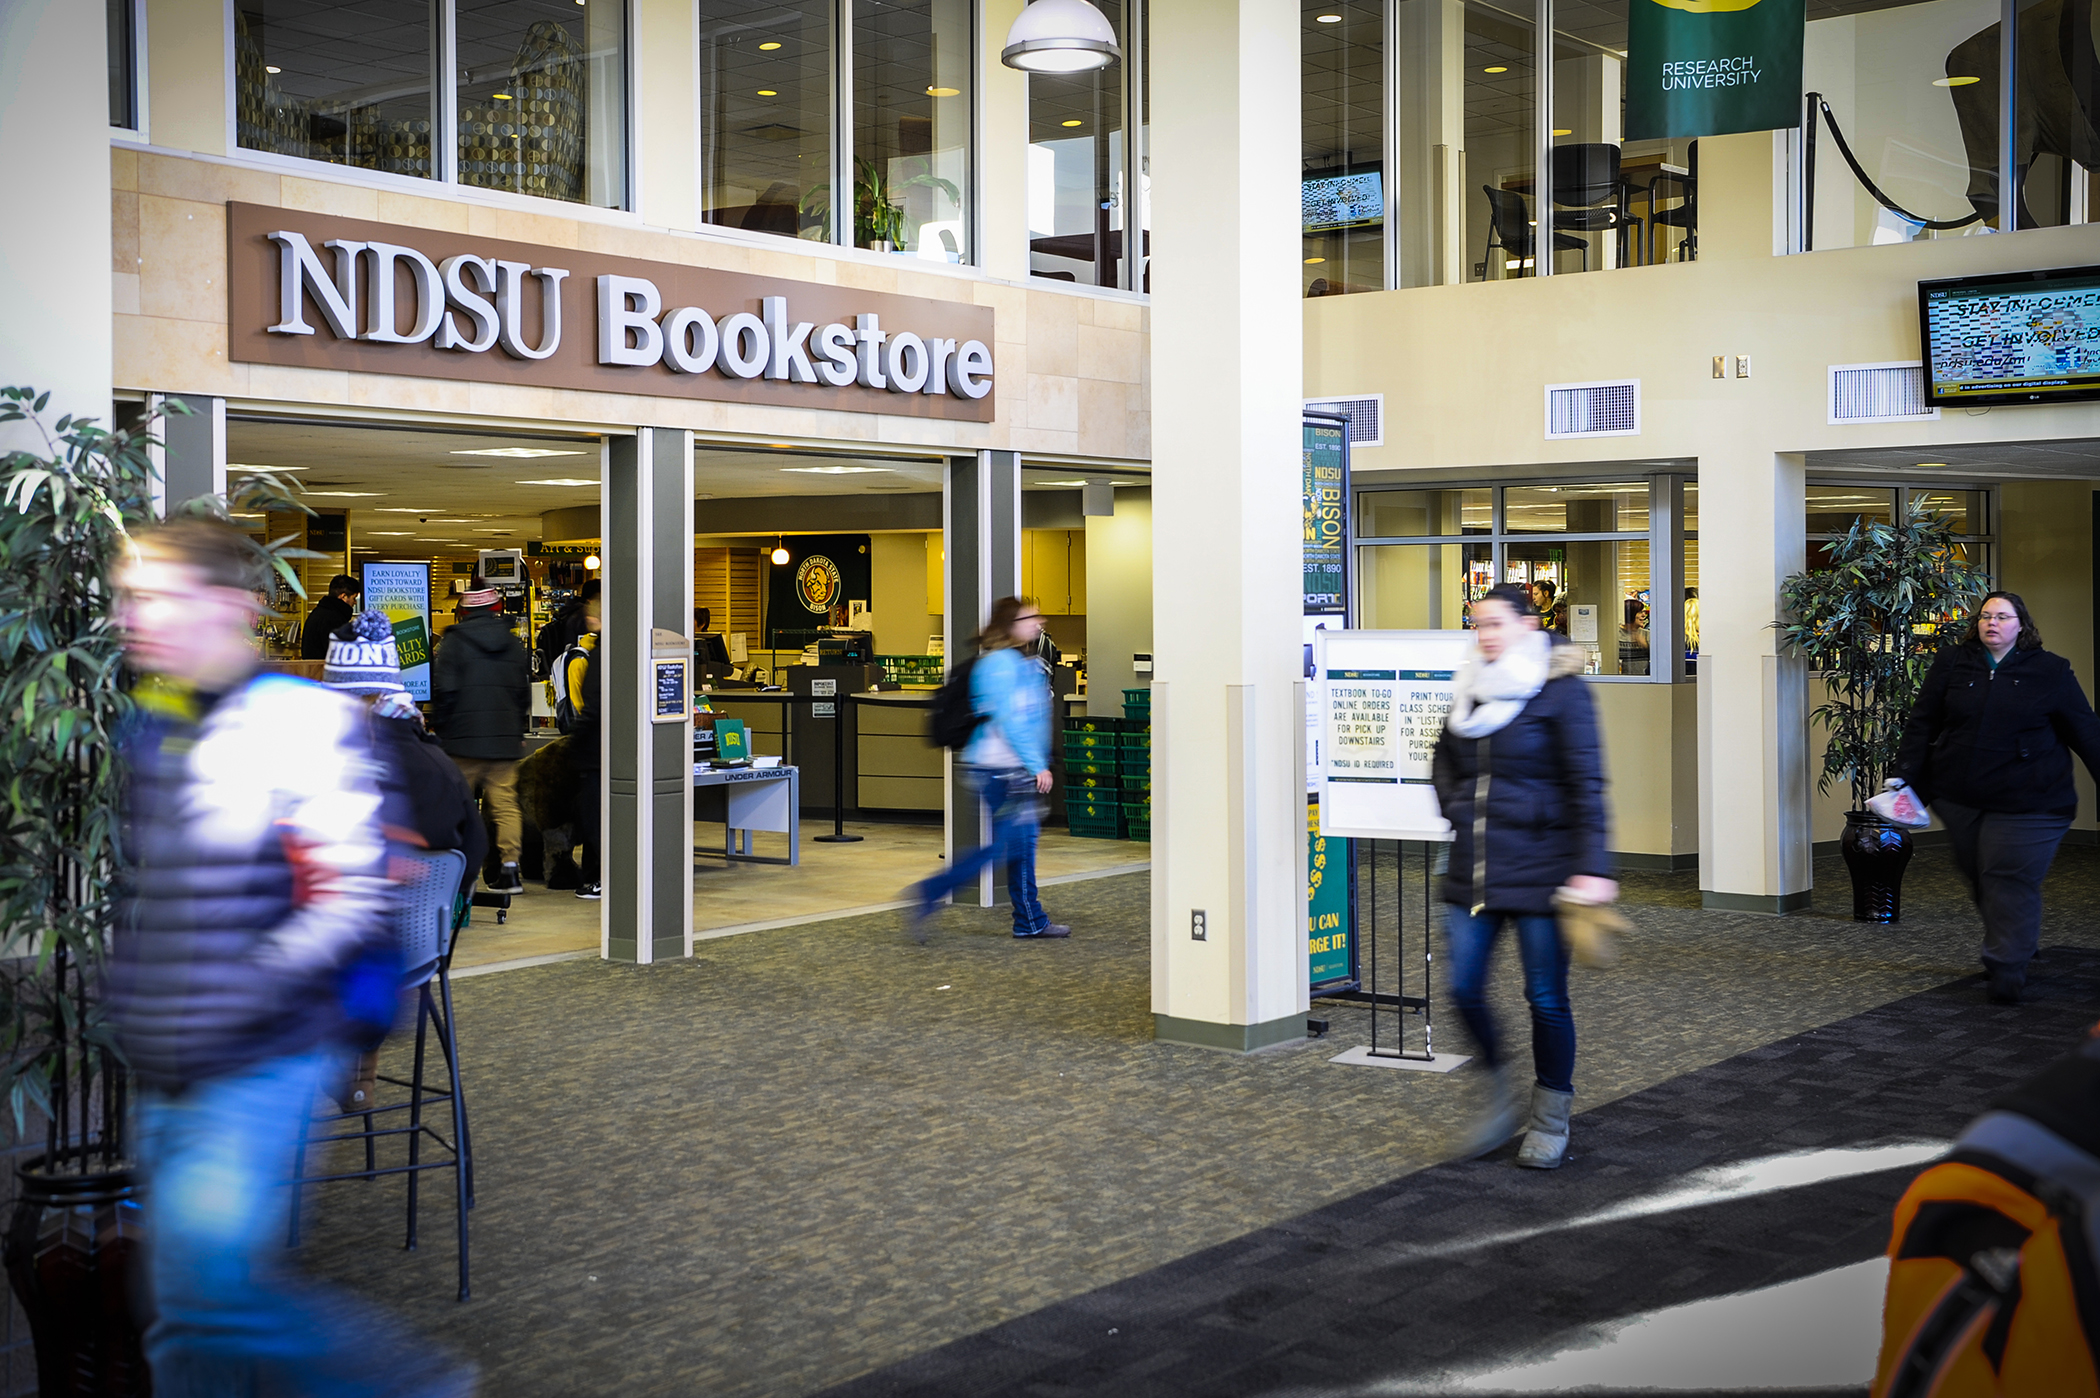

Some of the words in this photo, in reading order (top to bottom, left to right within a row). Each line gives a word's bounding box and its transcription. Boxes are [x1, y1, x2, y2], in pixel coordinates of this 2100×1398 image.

[1662, 56, 1753, 76] RESEARCH
[1661, 69, 1761, 90] UNIVERSITY
[1930, 291, 1947, 299] NDSU
[267, 229, 570, 361] NDSU
[597, 274, 994, 400] Bookstore
[1315, 428, 1341, 438] BISON
[1315, 466, 1341, 480] NDSU
[1322, 488, 1341, 549] BISON
[798, 561, 811, 580] NORTH
[809, 557, 829, 566] DAKOTA
[829, 564, 839, 583] STATE
[1303, 563, 1320, 573] EST.
[1322, 563, 1342, 573] 1890
[372, 570, 390, 578] EARN
[391, 570, 421, 578] LOYALTY
[371, 578, 394, 586] POINTS
[394, 578, 423, 586] TOWARD
[1303, 573, 1341, 593] NDSU
[367, 586, 386, 594] NDSU
[387, 586, 425, 594] BOOKSTORE
[810, 603, 827, 612] BISON
[395, 625, 420, 636] BOOKSTORE
[1331, 688, 1367, 698] TEXTBOOK
[1371, 688, 1392, 698] TO-GO
[1410, 691, 1432, 701] PRINT
[1434, 692, 1454, 702] YOUR
[1332, 700, 1358, 710] ONLINE
[1362, 700, 1390, 710] ORDERS
[1399, 703, 1423, 713] CLASS
[1334, 712, 1347, 721] ARE
[1351, 712, 1390, 722] AVAILABLE
[1404, 715, 1412, 724] IN
[1337, 723, 1351, 733] FOR
[1355, 723, 1372, 733] PICK
[1375, 724, 1386, 734] UP
[1400, 727, 1415, 737] FOR
[1338, 735, 1385, 746] DOWNSTAIRS
[1408, 751, 1428, 761] YOUR
[1353, 759, 1361, 768] ID
[1363, 760, 1394, 769] REQUIRED
[724, 772, 754, 781] UNDER
[755, 769, 792, 779] ARMOUR
[1307, 808, 1318, 817] PAY
[1318, 912, 1340, 930] CAN
[1332, 932, 1346, 950] IT!
